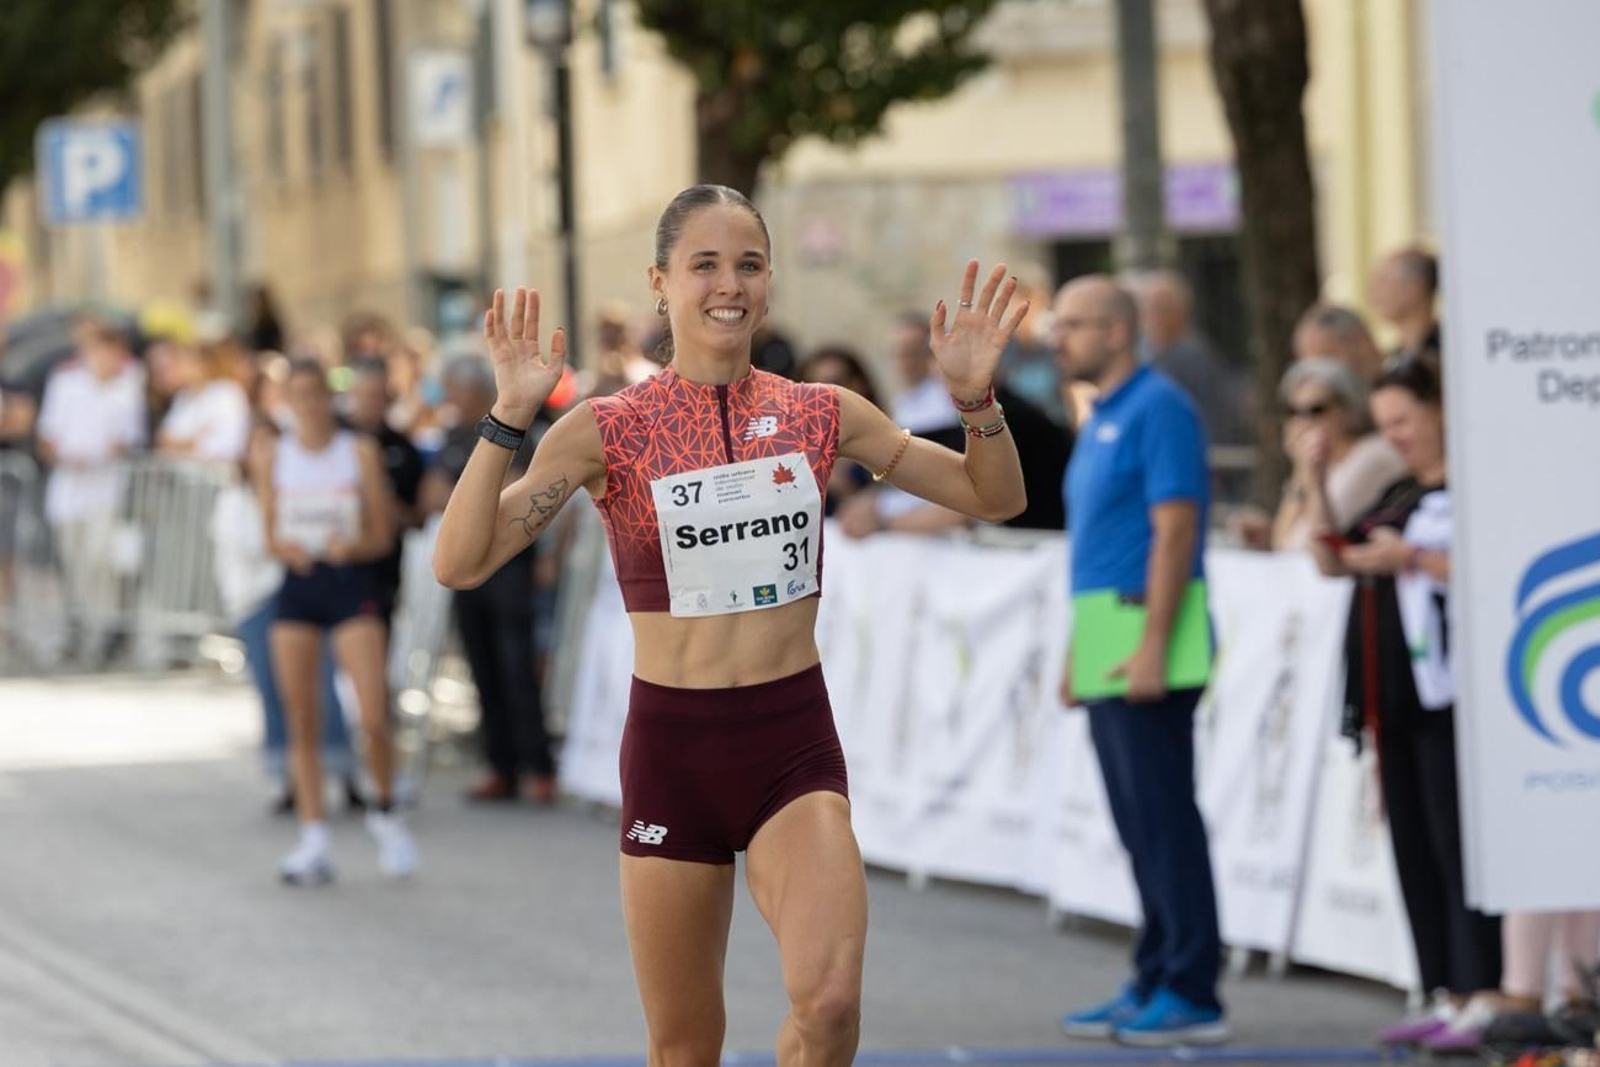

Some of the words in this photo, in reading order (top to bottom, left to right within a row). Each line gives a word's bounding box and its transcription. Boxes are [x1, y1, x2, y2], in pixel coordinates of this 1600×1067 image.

[63, 133, 121, 212] P
[671, 481, 703, 506] 37
[675, 511, 809, 549] Serrano
[782, 537, 809, 571] 31
[625, 819, 668, 845] NB
